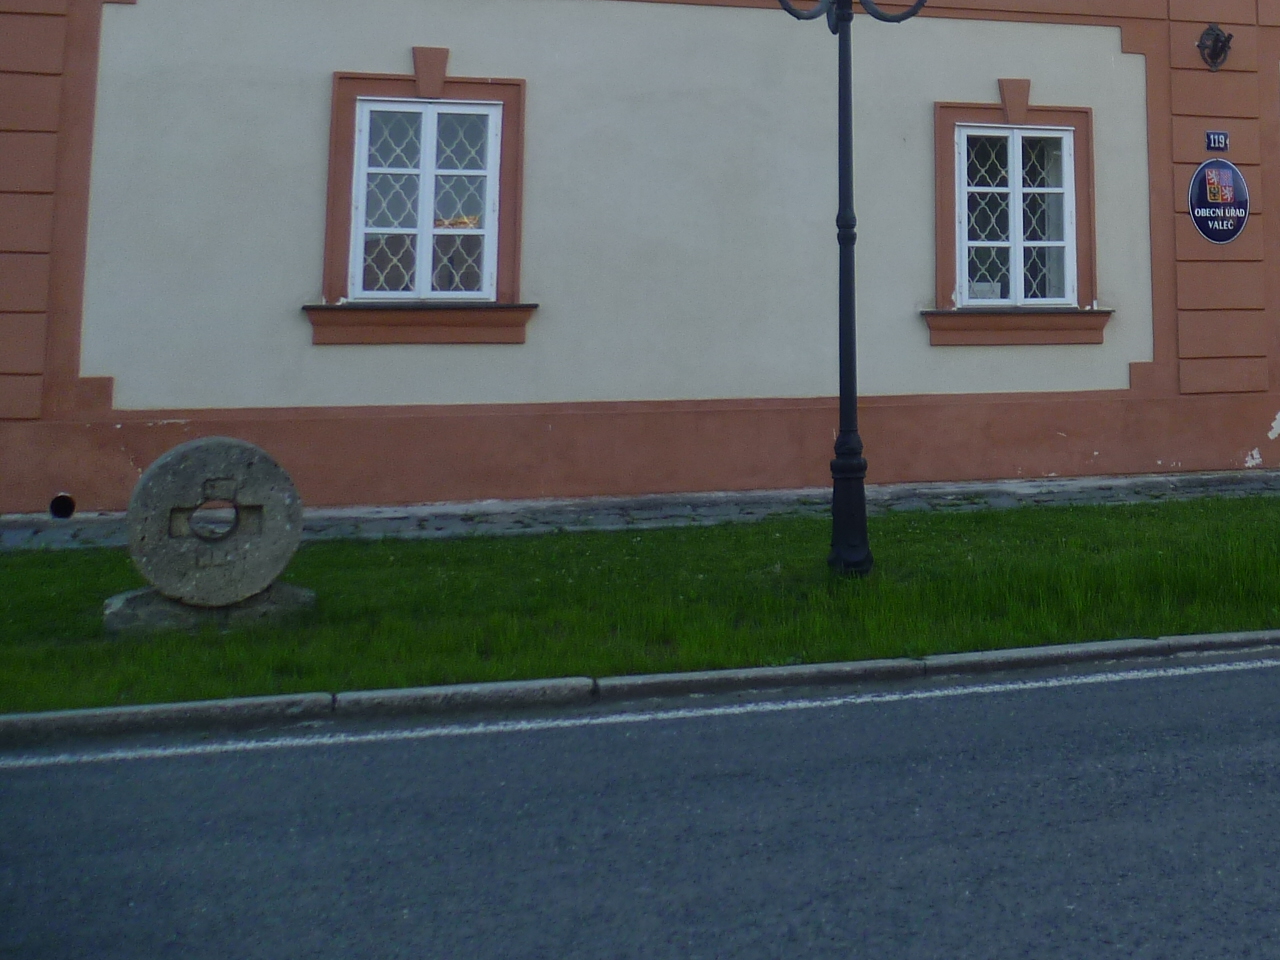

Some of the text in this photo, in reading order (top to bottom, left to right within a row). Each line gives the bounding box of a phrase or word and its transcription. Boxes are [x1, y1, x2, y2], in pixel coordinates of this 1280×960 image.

[1210, 134, 1225, 147] 119
[1194, 207, 1245, 217] OBECNÍ ÚŘAD
[1208, 219, 1234, 230] VALEČ
